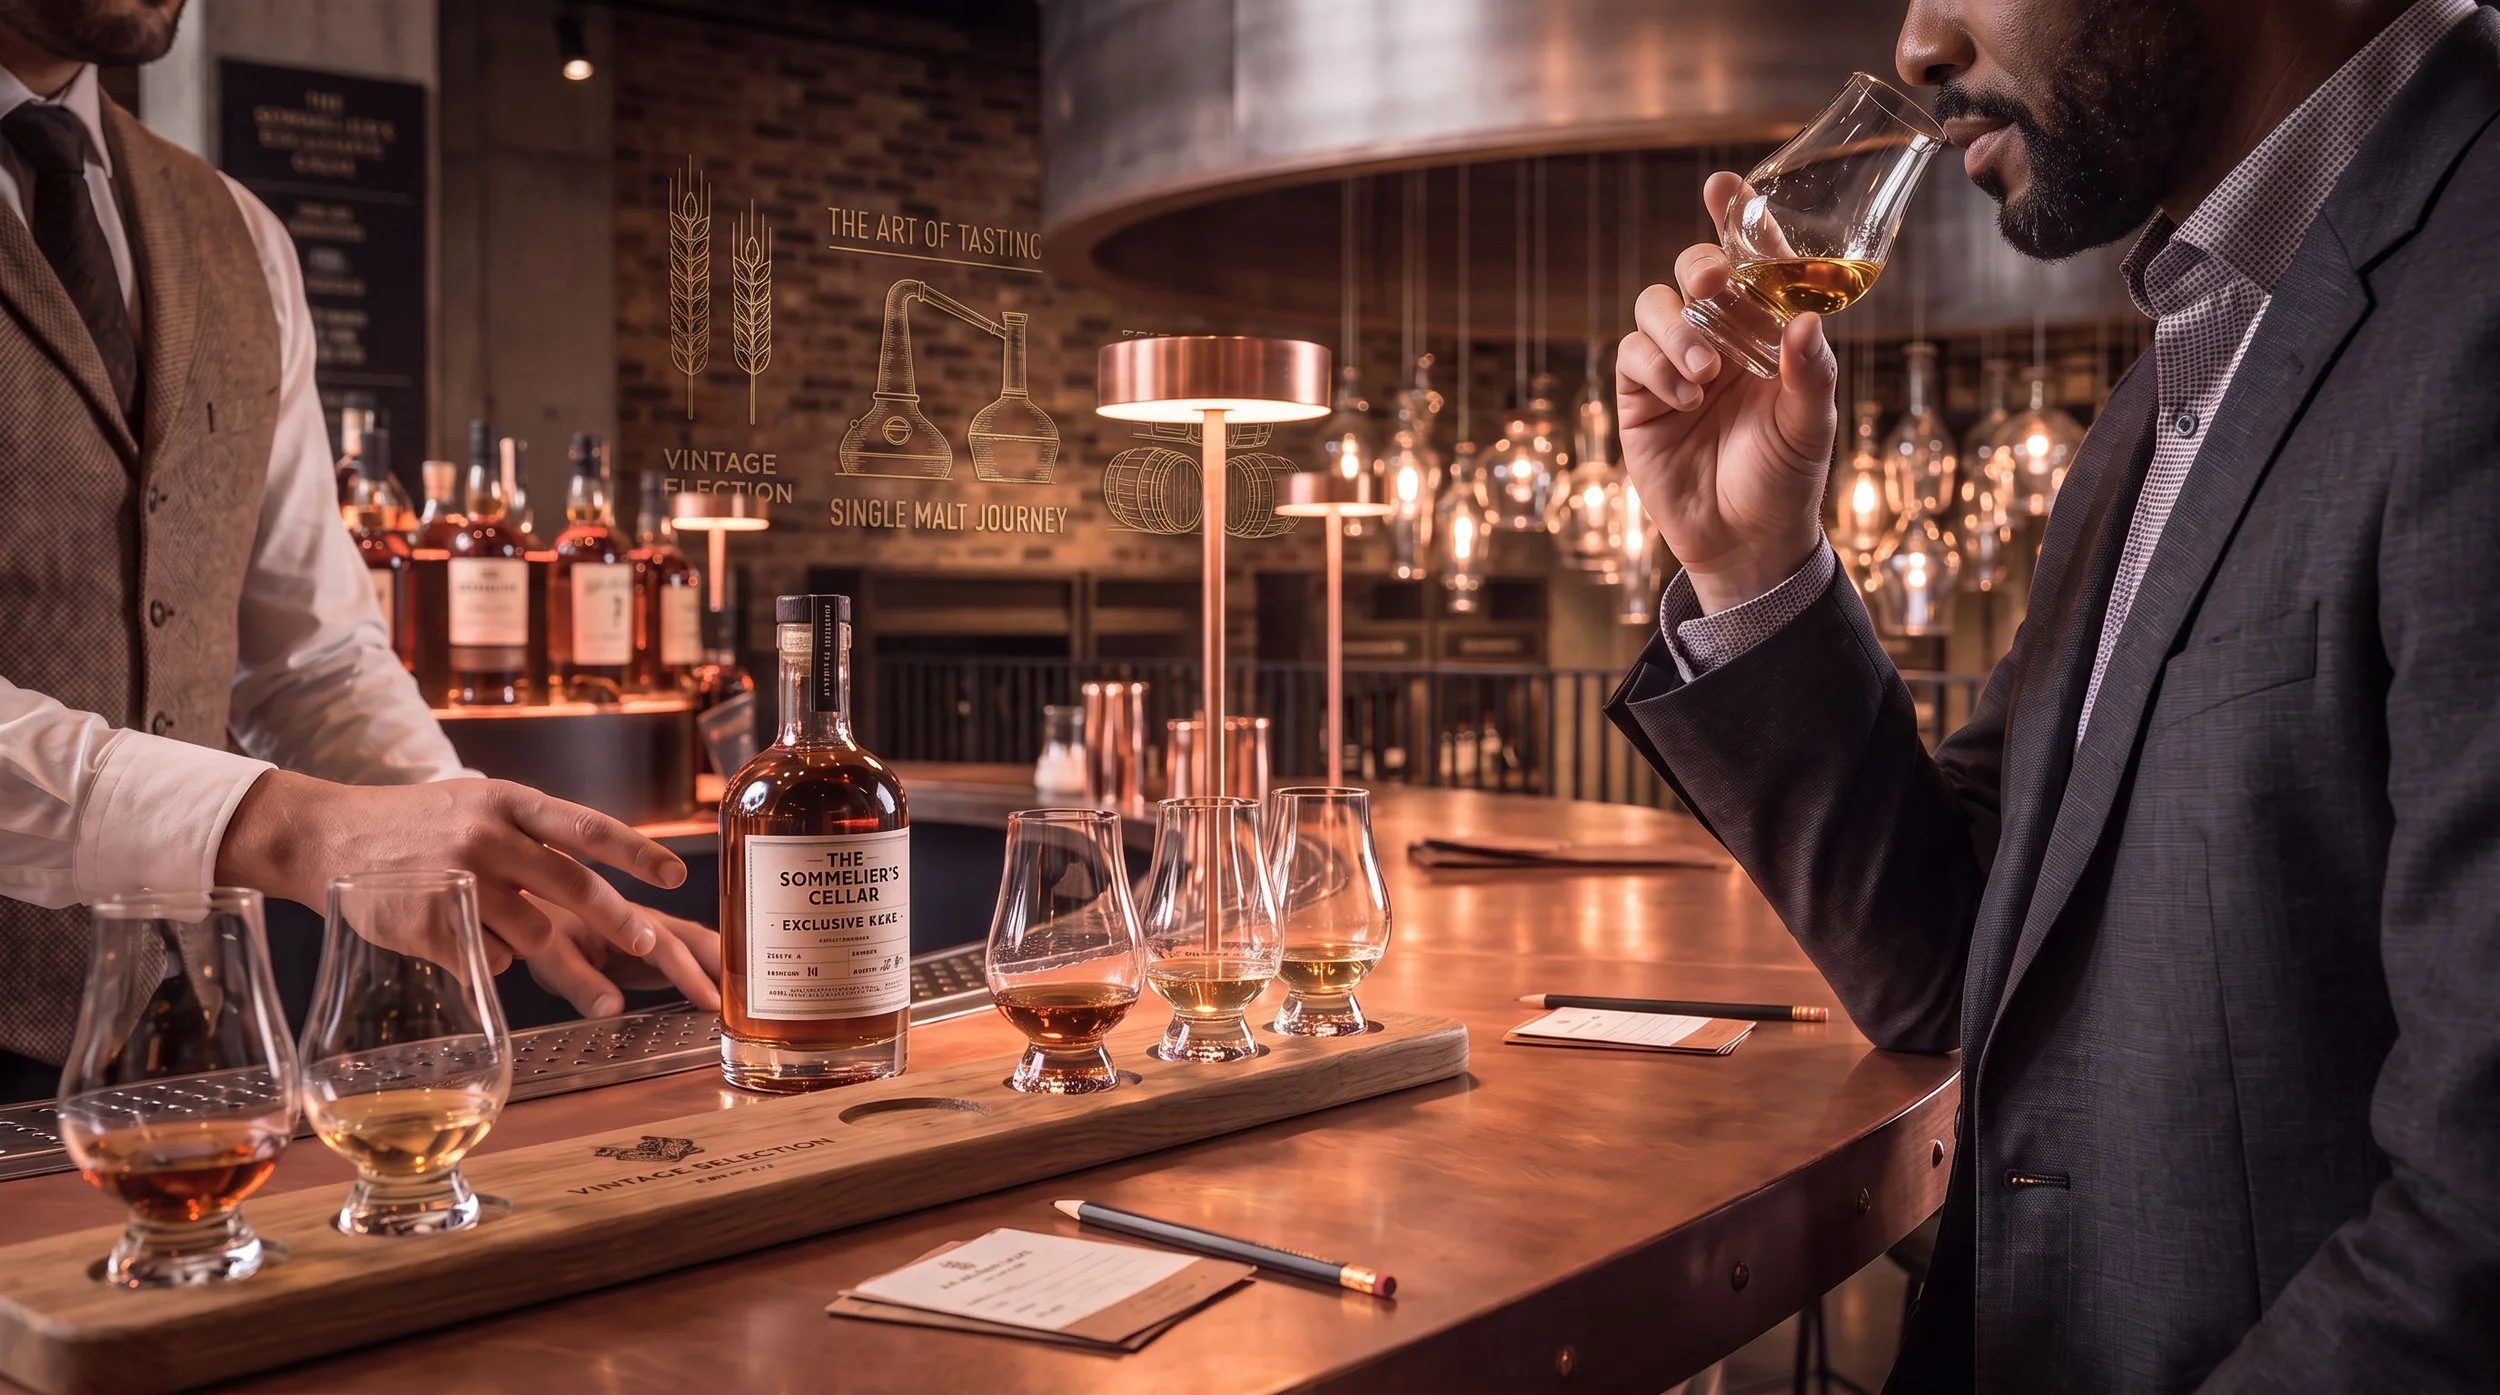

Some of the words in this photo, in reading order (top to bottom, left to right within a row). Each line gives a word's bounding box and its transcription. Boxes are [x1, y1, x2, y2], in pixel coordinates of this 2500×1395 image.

[828, 207, 870, 240] THE
[876, 213, 918, 245] ART
[925, 220, 951, 249] OF
[958, 224, 1041, 260] TASTING
[664, 448, 777, 475] VINTAGE
[830, 498, 907, 529] SINGLE
[914, 501, 967, 531] MALT
[975, 504, 1067, 533] JOURNEY
[827, 851, 864, 867] THE
[780, 865, 900, 887] SOMMELIER'S
[808, 887, 880, 905] CELLAR
[782, 916, 864, 932] EXCLUSIVE
[567, 1167, 692, 1196] VINTAGE
[691, 1137, 836, 1170] SELECTION
